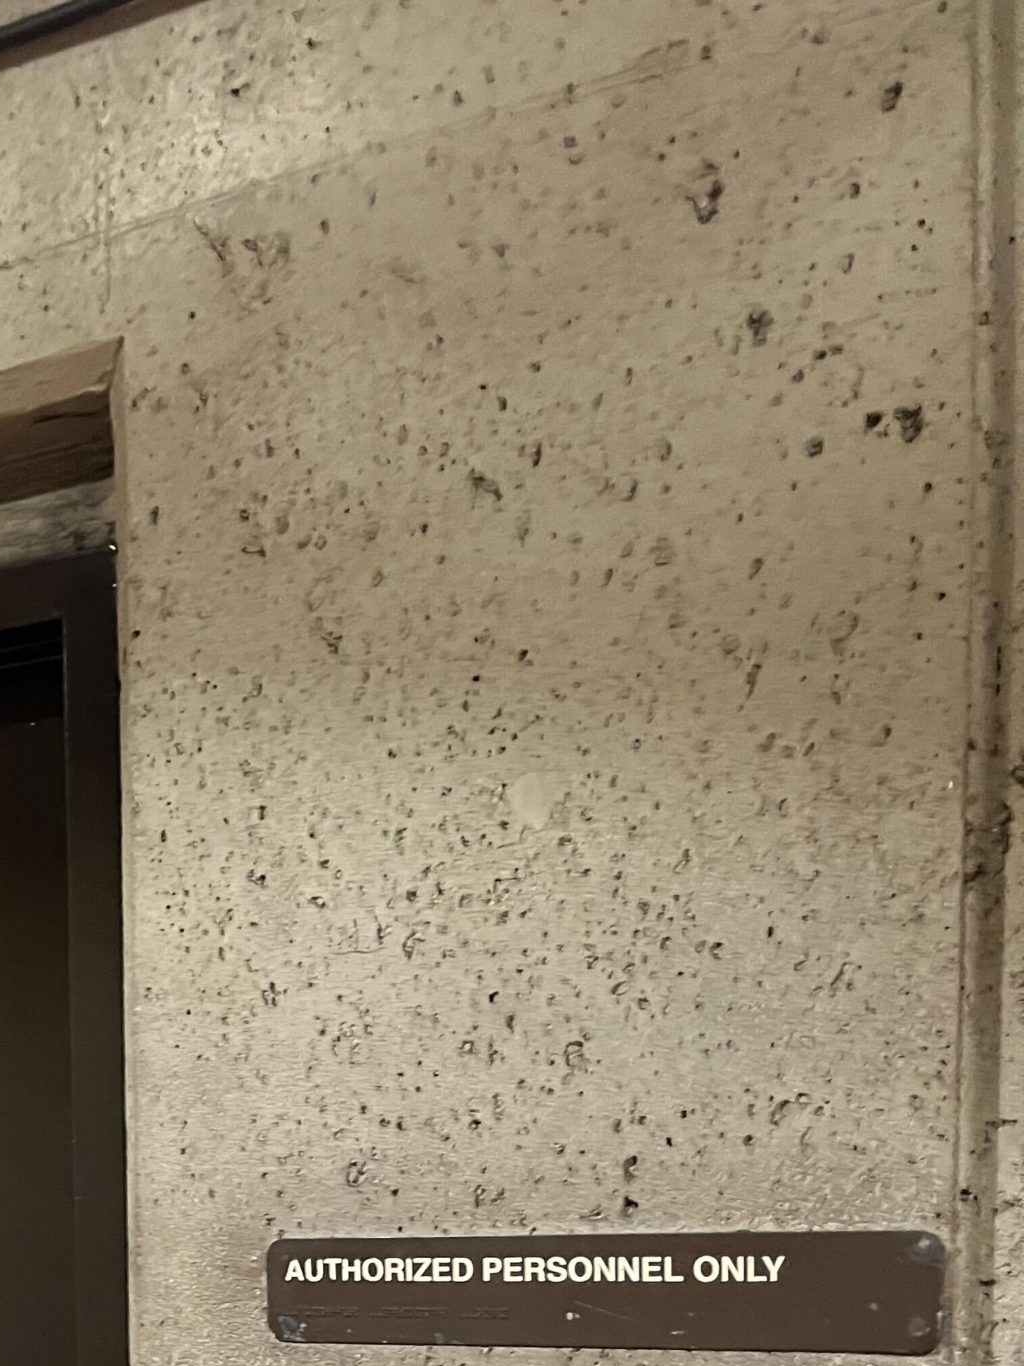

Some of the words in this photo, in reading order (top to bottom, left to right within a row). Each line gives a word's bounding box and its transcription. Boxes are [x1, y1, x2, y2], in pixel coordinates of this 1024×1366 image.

[284, 1257, 474, 1283] AUTHORIZED
[482, 1256, 684, 1283] PERSONNEL
[693, 1255, 786, 1283] ONLY
